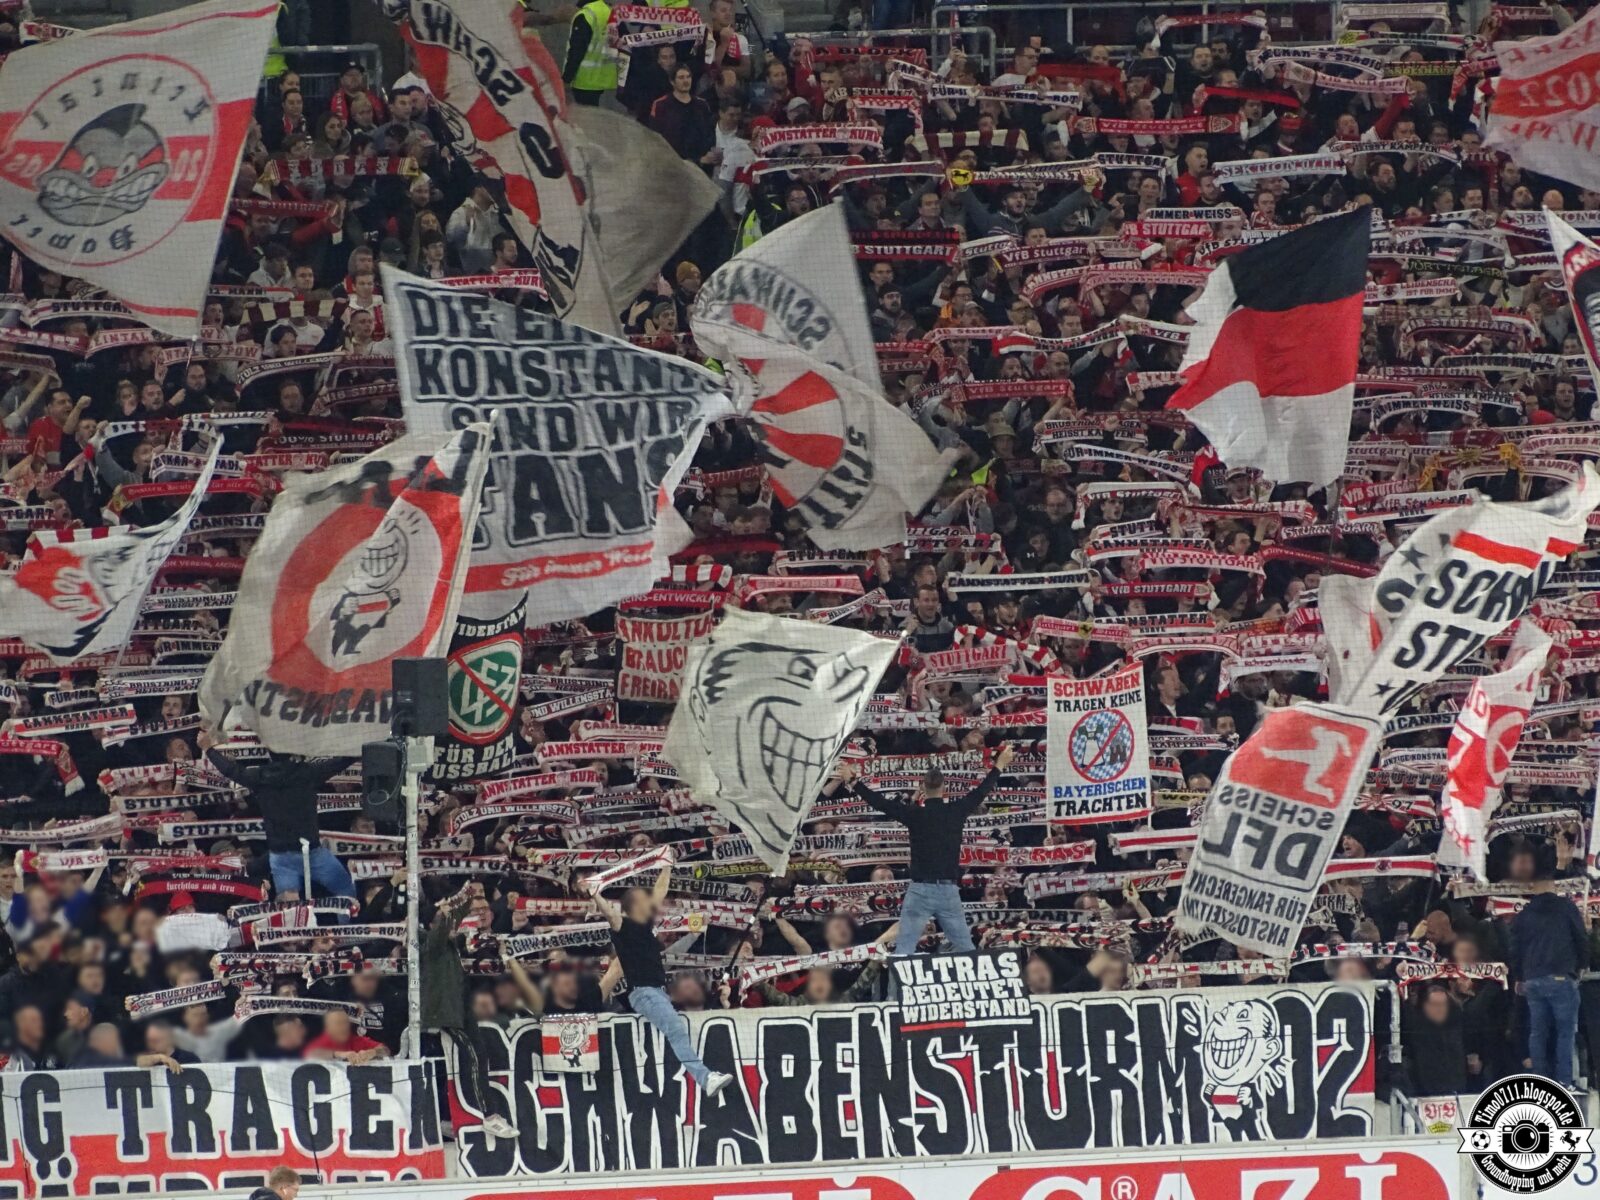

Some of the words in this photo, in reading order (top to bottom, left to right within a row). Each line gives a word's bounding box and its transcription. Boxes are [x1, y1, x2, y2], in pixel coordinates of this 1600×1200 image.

[849, 129, 882, 145] KURV
[415, 344, 722, 397] KONSTANT
[709, 466, 760, 482] STUTTGA
[1344, 486, 1363, 502] VfB
[190, 515, 266, 529] CANNSTA
[1111, 519, 1156, 538] STUTT
[625, 645, 688, 674] BRAUC
[929, 645, 1007, 668] STUTTGART
[1053, 671, 1141, 698] SCHWABEN
[1054, 697, 1107, 713] TRAGEN
[1110, 690, 1142, 707] KEINE
[22, 706, 129, 729] CANNSTATTER
[130, 714, 202, 736] STUTTGA
[436, 743, 474, 764] FÜR
[482, 732, 514, 760] DEN
[1053, 777, 1147, 799] BAYERISCHEN
[124, 790, 236, 810] STUTTGART
[1053, 792, 1148, 817] TRACHTEN
[173, 821, 265, 838] STUTTGA
[504, 928, 610, 956] SCHWABENSTUR
[894, 952, 1021, 985] ULTRAS
[901, 978, 1025, 1007] BEDEUTET
[902, 998, 1031, 1024] WIDERSTAND
[104, 1063, 440, 1156] TRAGEN
